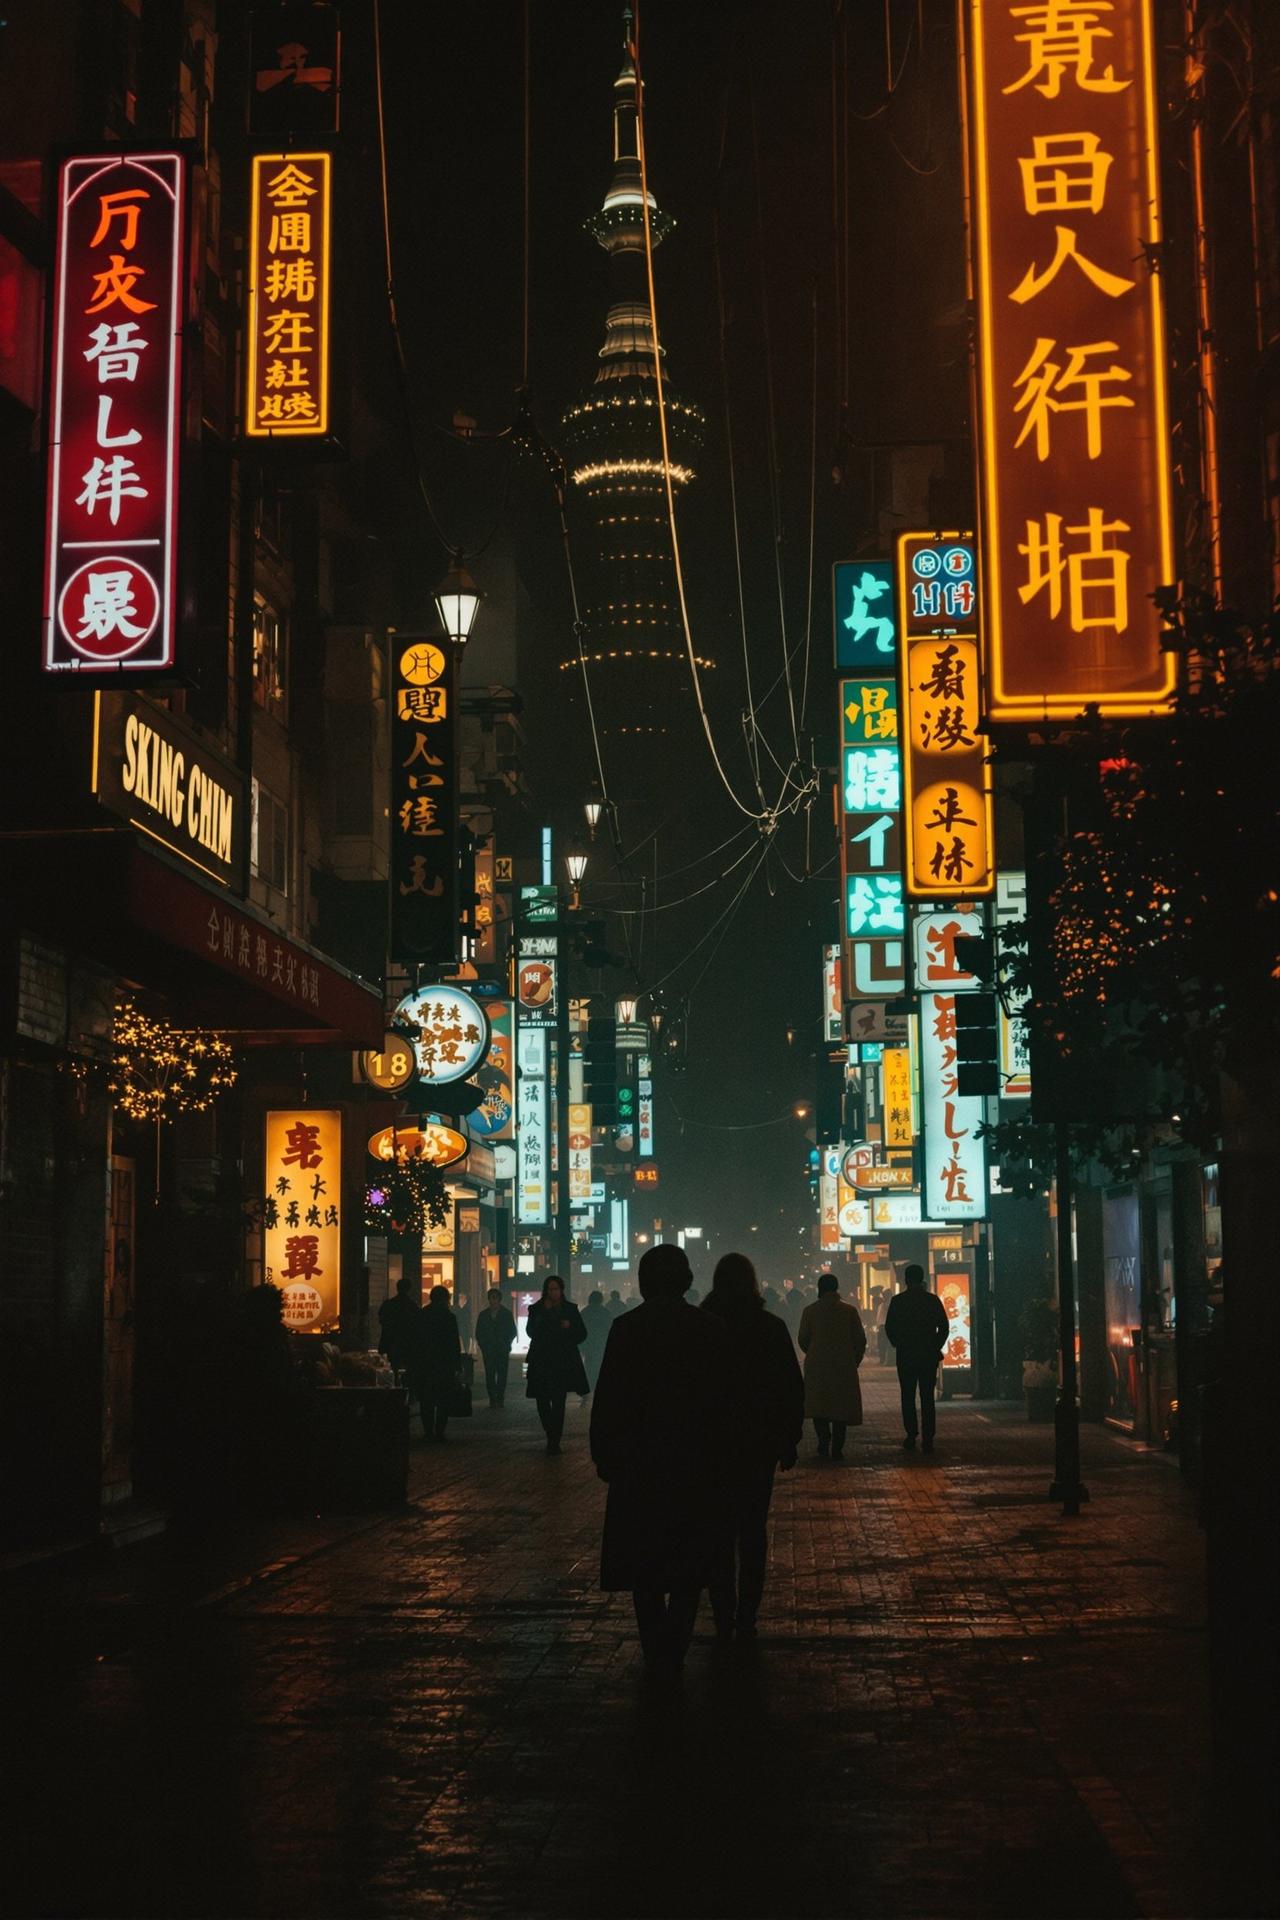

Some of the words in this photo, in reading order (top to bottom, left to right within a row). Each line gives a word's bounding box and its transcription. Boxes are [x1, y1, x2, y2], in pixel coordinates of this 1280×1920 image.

[122, 714, 185, 828] SKING
[188, 764, 233, 864] CHIM
[371, 1052, 408, 1077] 18
